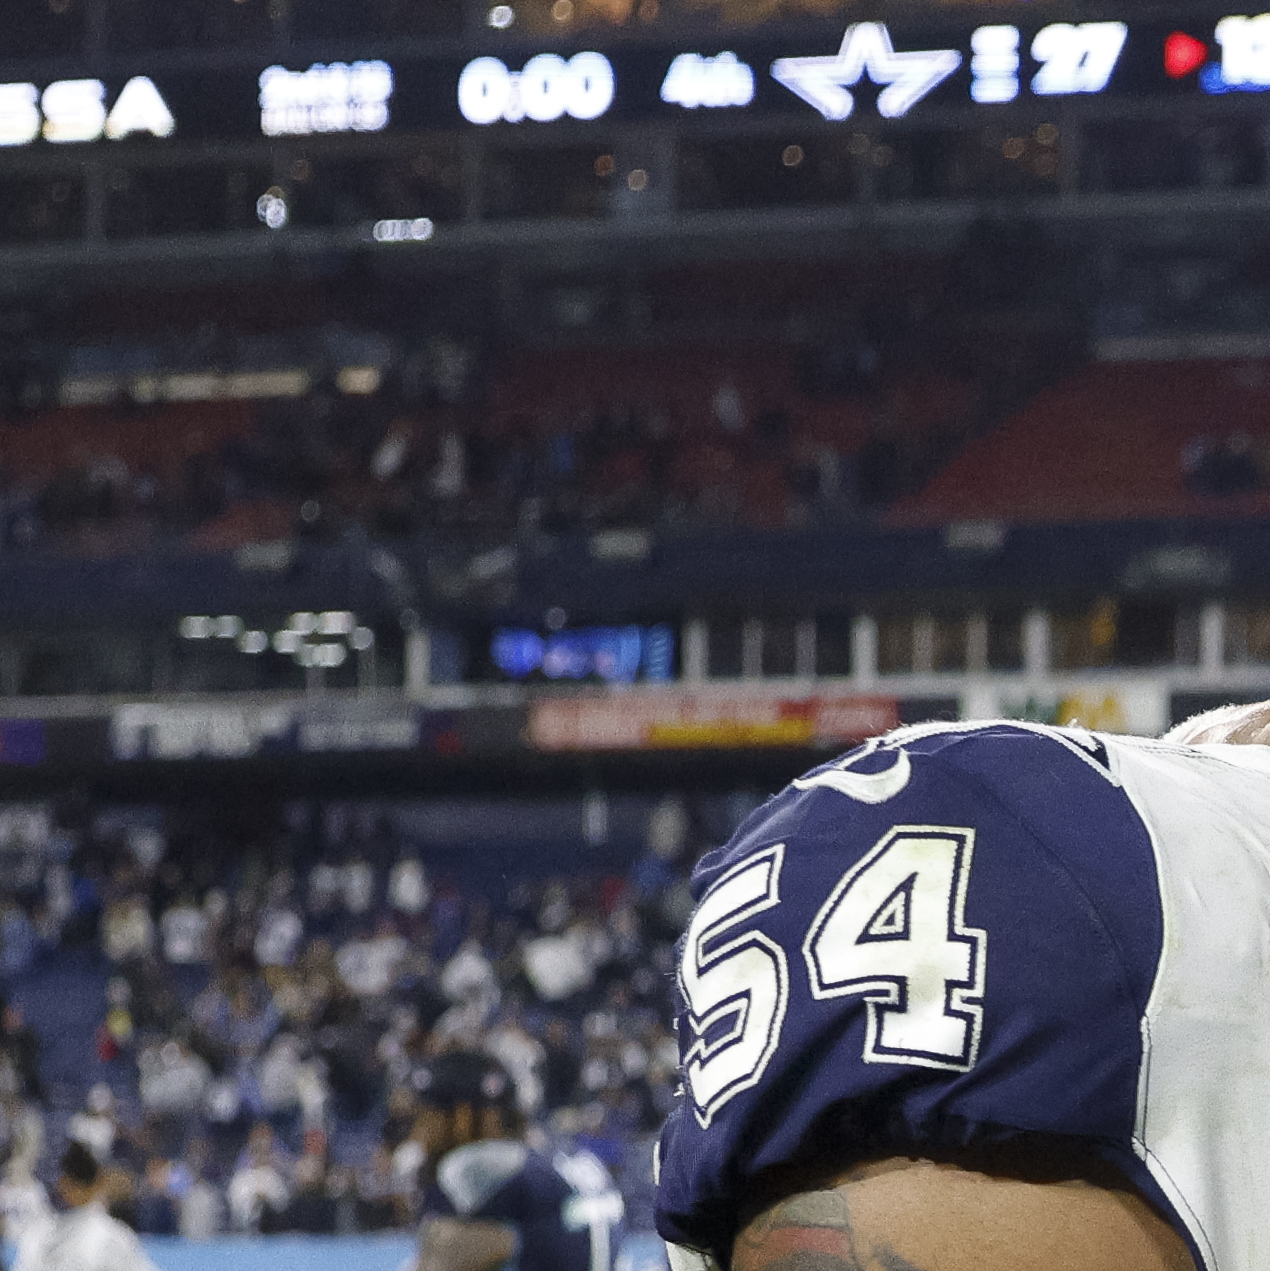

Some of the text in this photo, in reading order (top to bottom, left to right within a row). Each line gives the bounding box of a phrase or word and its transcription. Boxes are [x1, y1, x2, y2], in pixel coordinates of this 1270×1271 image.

[458, 51, 615, 125] 0:00
[1031, 21, 1128, 94] 27
[676, 824, 988, 1130] 54
